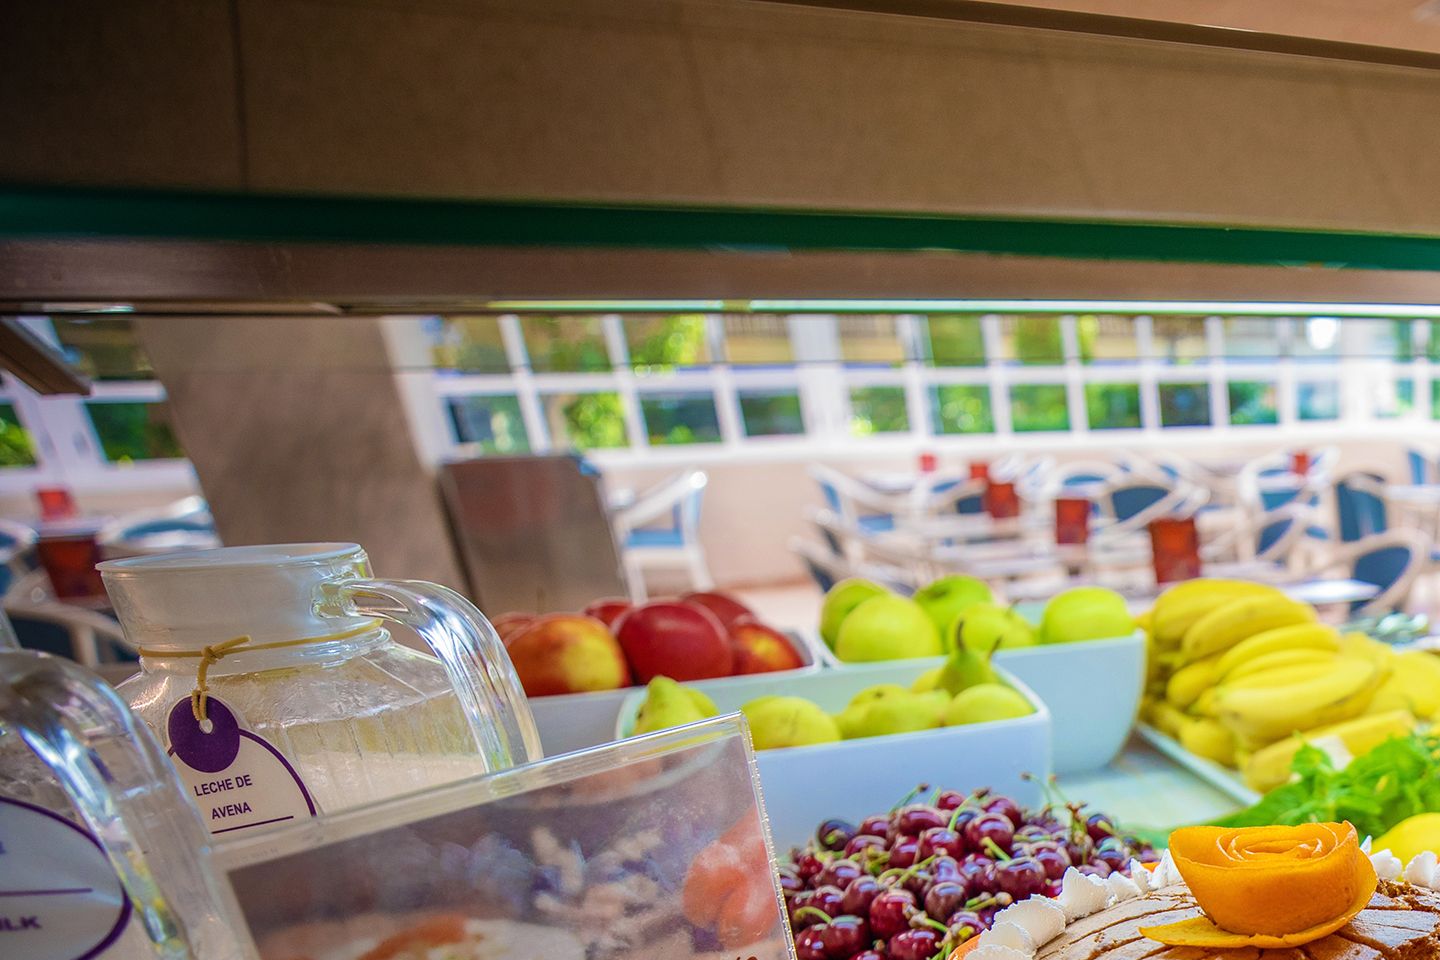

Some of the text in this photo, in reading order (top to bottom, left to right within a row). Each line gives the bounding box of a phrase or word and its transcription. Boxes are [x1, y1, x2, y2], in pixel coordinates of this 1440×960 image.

[194, 775, 253, 796] LECHE DE
[211, 802, 252, 819] AVENA
